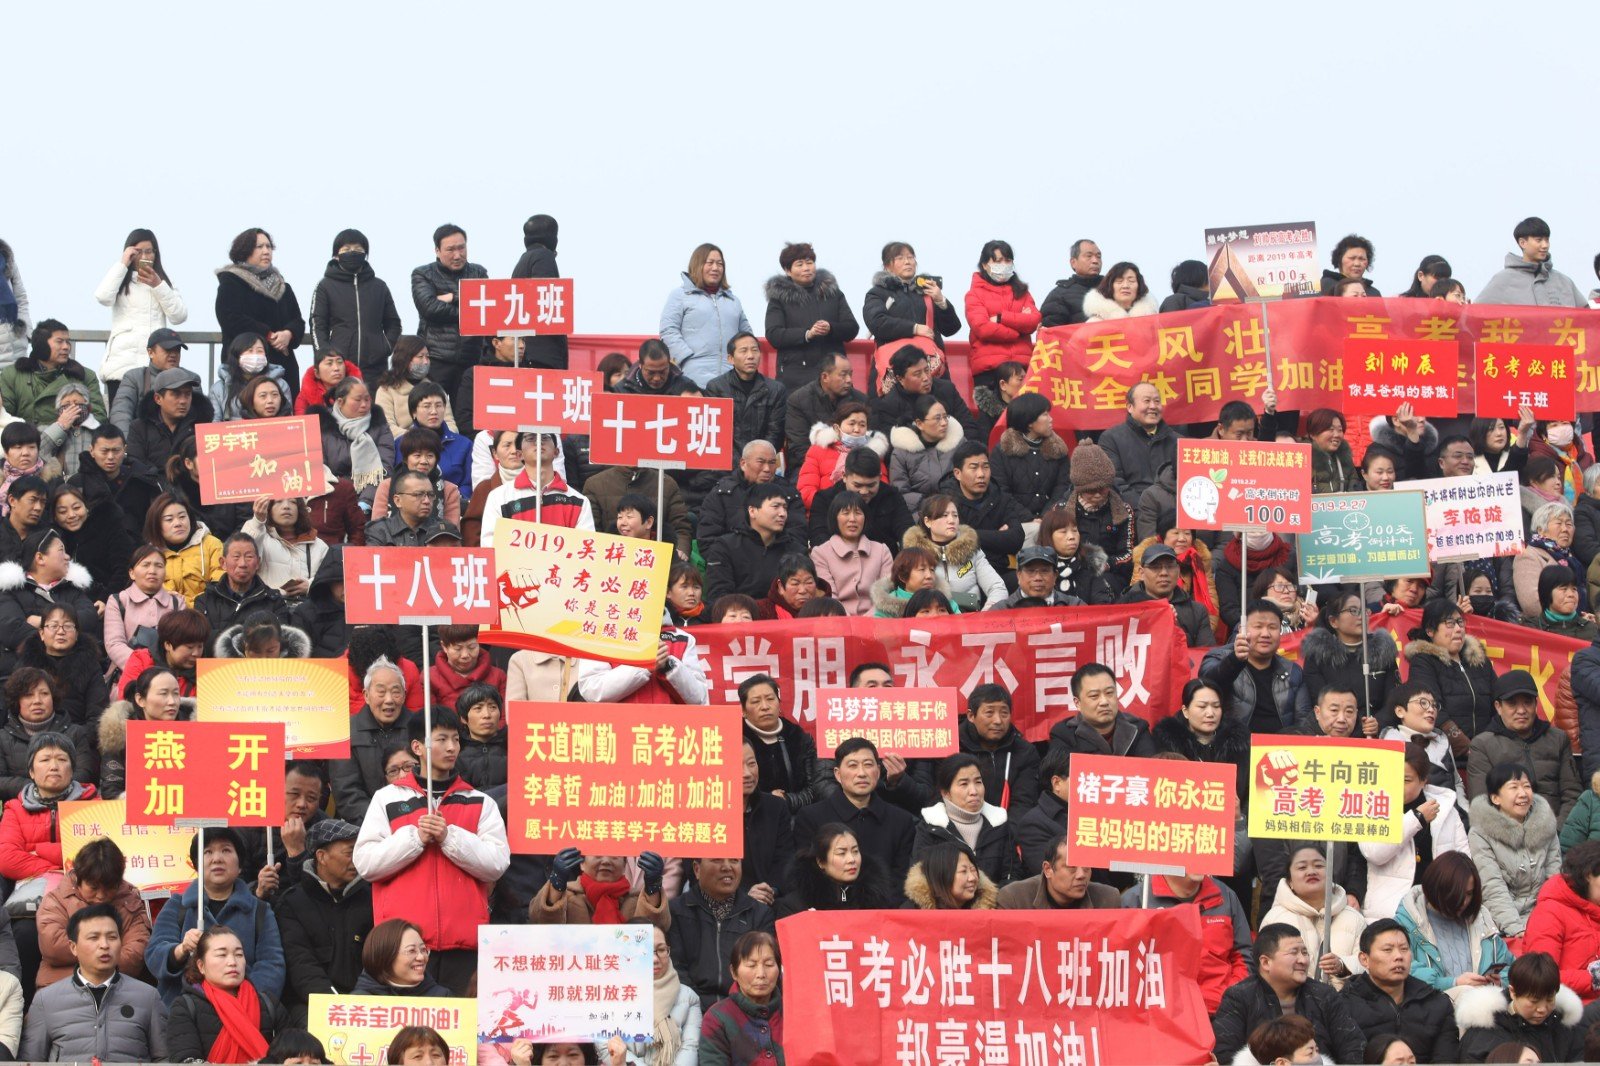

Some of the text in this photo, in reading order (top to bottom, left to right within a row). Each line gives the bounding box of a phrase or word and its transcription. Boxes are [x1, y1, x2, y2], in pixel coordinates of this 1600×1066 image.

[1267, 252, 1286, 260] 2019
[1289, 250, 1313, 260] 年高考
[469, 284, 565, 326] 十九班
[1365, 351, 1435, 376] 刘帅辰
[1483, 353, 1567, 379] 高考必胜
[487, 375, 593, 423] 二十班
[1348, 383, 1455, 399] 你是爸妈的骄傲!
[1502, 390, 1548, 407] 十五班
[204, 431, 259, 453] 罗宇轩
[602, 401, 721, 457] 十七班
[1245, 488, 1300, 501] 高考倒计时
[1311, 525, 1369, 551] 高考
[359, 554, 491, 611] 十八班
[144, 731, 269, 771] 燕 开
[525, 722, 724, 766] 天道酬勤 高考必胜
[1303, 759, 1380, 786] 牛向前
[144, 777, 267, 818] 加 油
[524, 773, 582, 807] 李睿哲
[1272, 784, 1391, 819] 高考 加油
[525, 818, 727, 844] 愿十八班莘莘学子金榜题名
[1075, 816, 1226, 855] 是妈妈的骄傲!
[1265, 819, 1390, 837] 妈妈相信你 你是最棒的
[493, 954, 620, 973] 不想被别人耻笑
[819, 934, 1166, 1009] 高考必胜十八班加油
[548, 985, 638, 1002] 那就别放弃
[328, 1004, 459, 1030] 希希宝贝加油!
